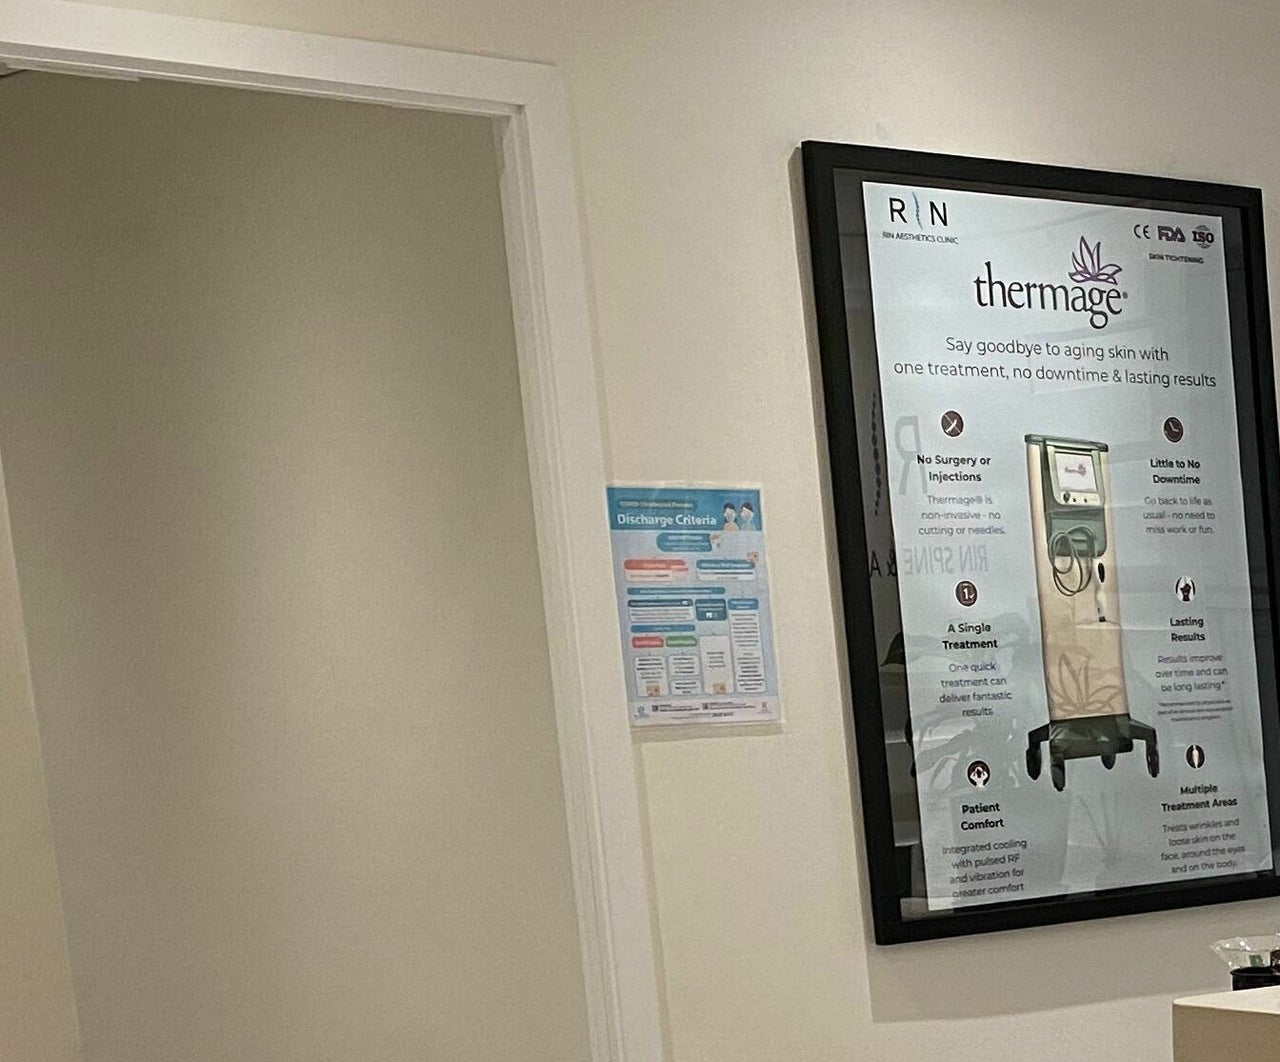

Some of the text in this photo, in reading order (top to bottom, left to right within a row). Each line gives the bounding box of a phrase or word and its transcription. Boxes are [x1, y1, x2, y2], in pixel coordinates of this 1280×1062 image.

[882, 231, 959, 244] RIN AESTHETICS CLINIC
[1133, 224, 1151, 240] CE
[1158, 226, 1185, 242] FDA
[1192, 229, 1214, 244] ISO
[946, 336, 1169, 361] Say goodbye to aging skin with
[894, 362, 1217, 388] one treatment, no downtime & lasting results
[917, 454, 991, 467] No Surgery or
[1150, 458, 1201, 469] Little to No
[929, 471, 982, 483] Injections
[1152, 474, 1201, 484] Downtime
[985, 496, 993, 504] is
[1144, 496, 1156, 505] Go
[1179, 497, 1188, 505] to
[617, 513, 717, 528] Discharge Criteria
[1172, 512, 1183, 520] no
[1185, 511, 1205, 520] need
[1206, 512, 1215, 520] to
[918, 526, 954, 537] cutting
[955, 527, 965, 535] or
[1167, 525, 1187, 534] work
[948, 622, 991, 635] A Single
[1170, 617, 1204, 628] Lasting
[1171, 632, 1206, 642] Results
[942, 639, 999, 650] Treatment
[949, 662, 997, 673] One quick
[940, 678, 988, 688] treatment
[1173, 682, 1192, 692] long
[939, 690, 1013, 703] deliver fantastic
[1180, 784, 1218, 795] Multiple
[962, 802, 1000, 814] Patient
[1161, 798, 1238, 812] Treatment Areas
[960, 819, 1004, 831] Comfort
[1224, 818, 1240, 827] and
[942, 839, 1027, 856] Integrated cooling
[1182, 849, 1211, 859] around
[1212, 847, 1226, 855] the
[951, 859, 973, 869] with
[974, 856, 1006, 868] pulsed
[1171, 865, 1187, 873] and
[1201, 862, 1215, 870] the
[949, 868, 1024, 884] and vibration for
[987, 883, 1025, 894] comfort
